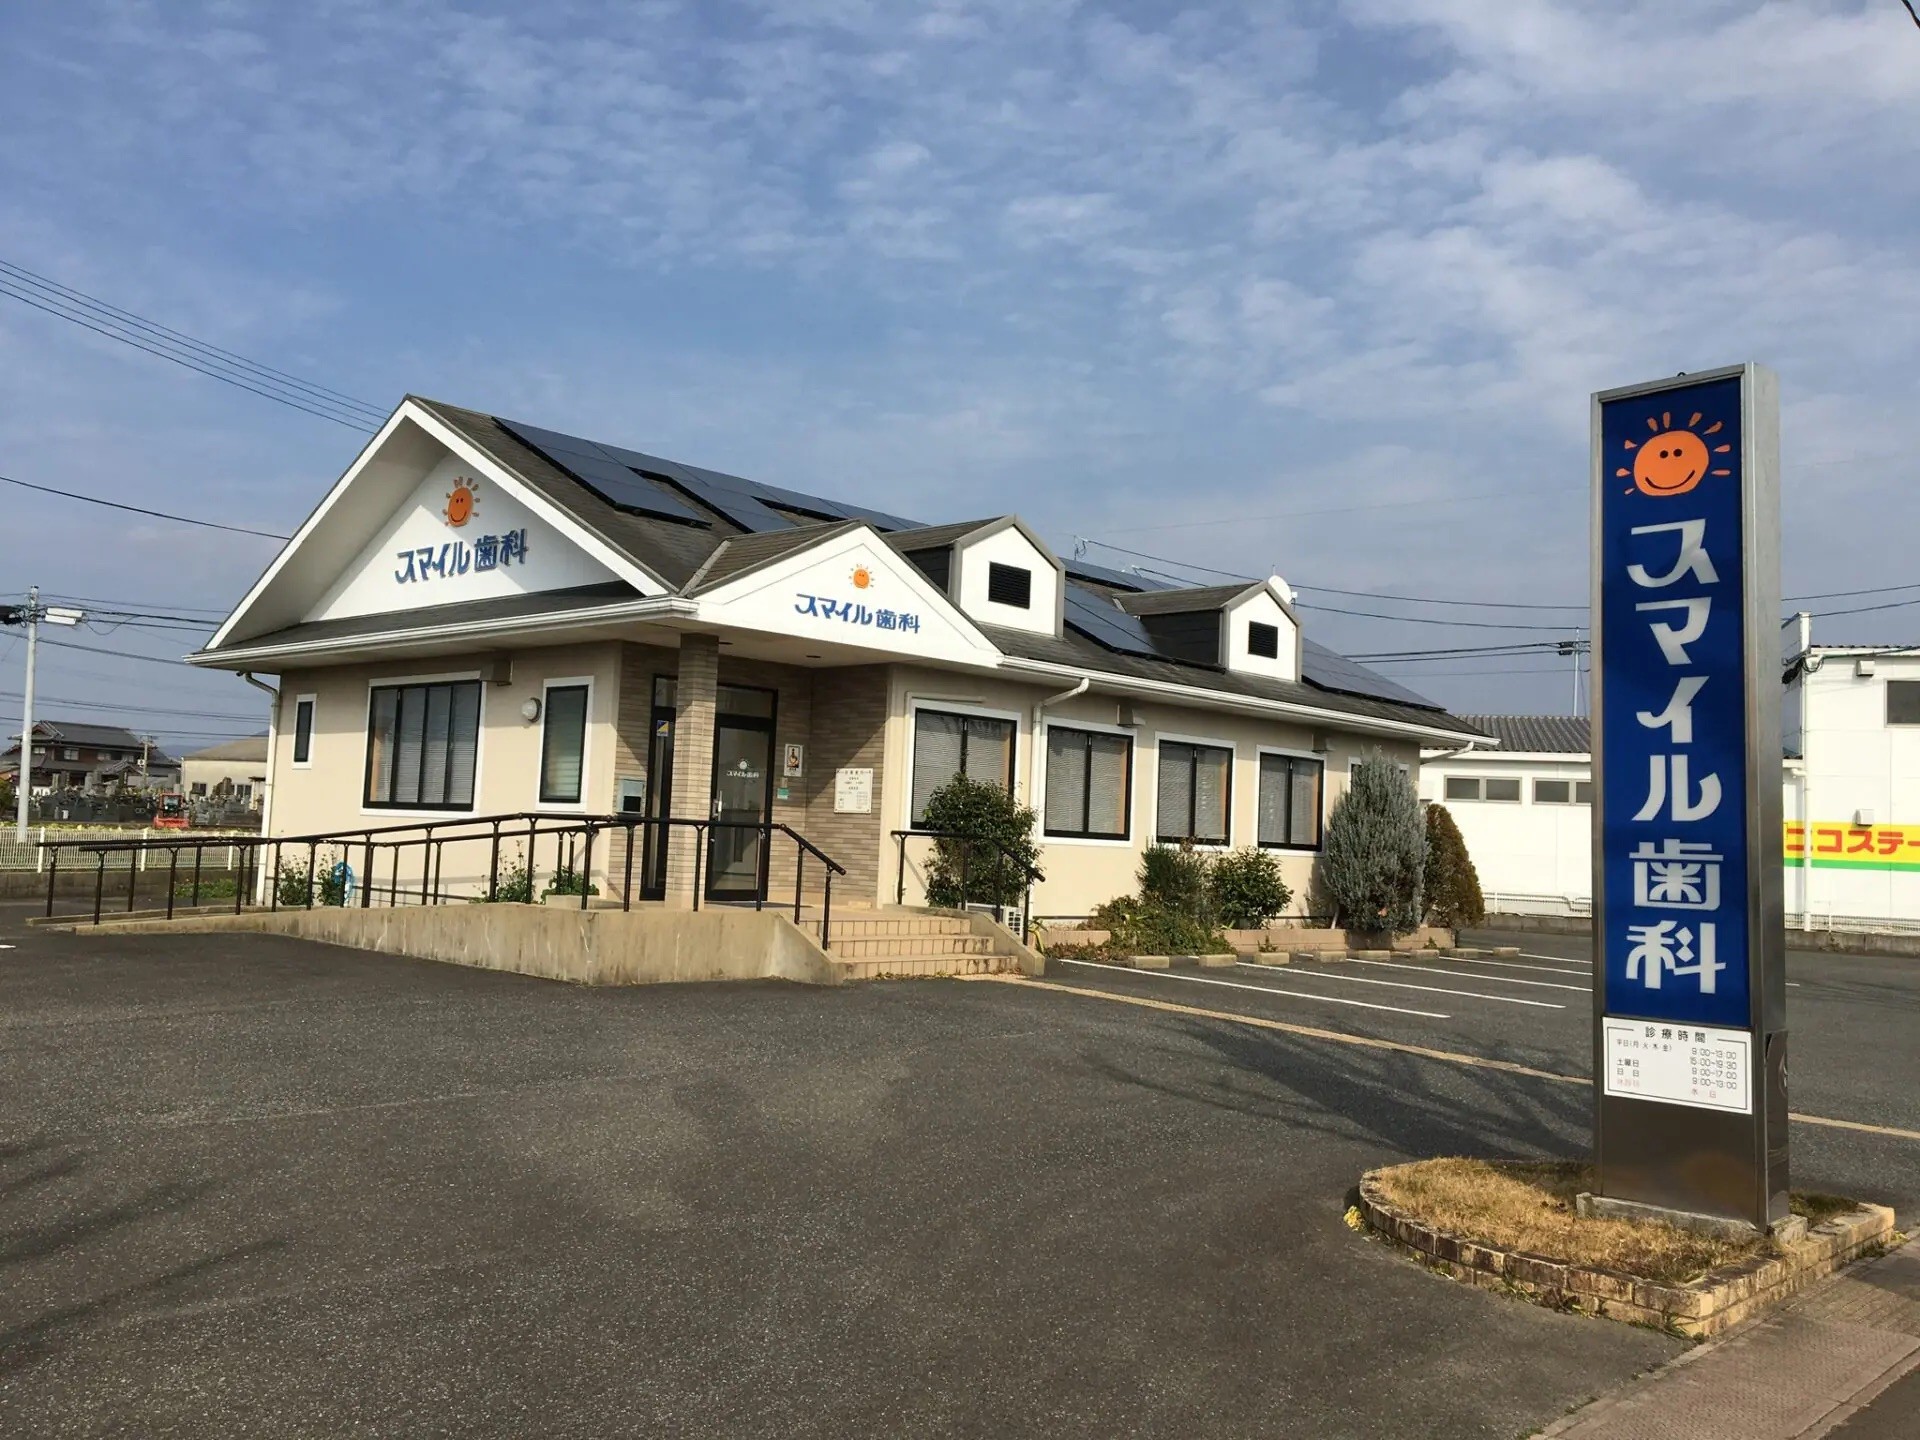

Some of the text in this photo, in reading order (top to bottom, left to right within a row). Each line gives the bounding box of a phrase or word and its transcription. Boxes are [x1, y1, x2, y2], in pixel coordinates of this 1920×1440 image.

[394, 528, 529, 584] スマイル歯科
[794, 593, 920, 634] スマイル歯科
[1626, 518, 1726, 994] スマイル歯科
[1645, 1026, 1706, 1044] 診療時間
